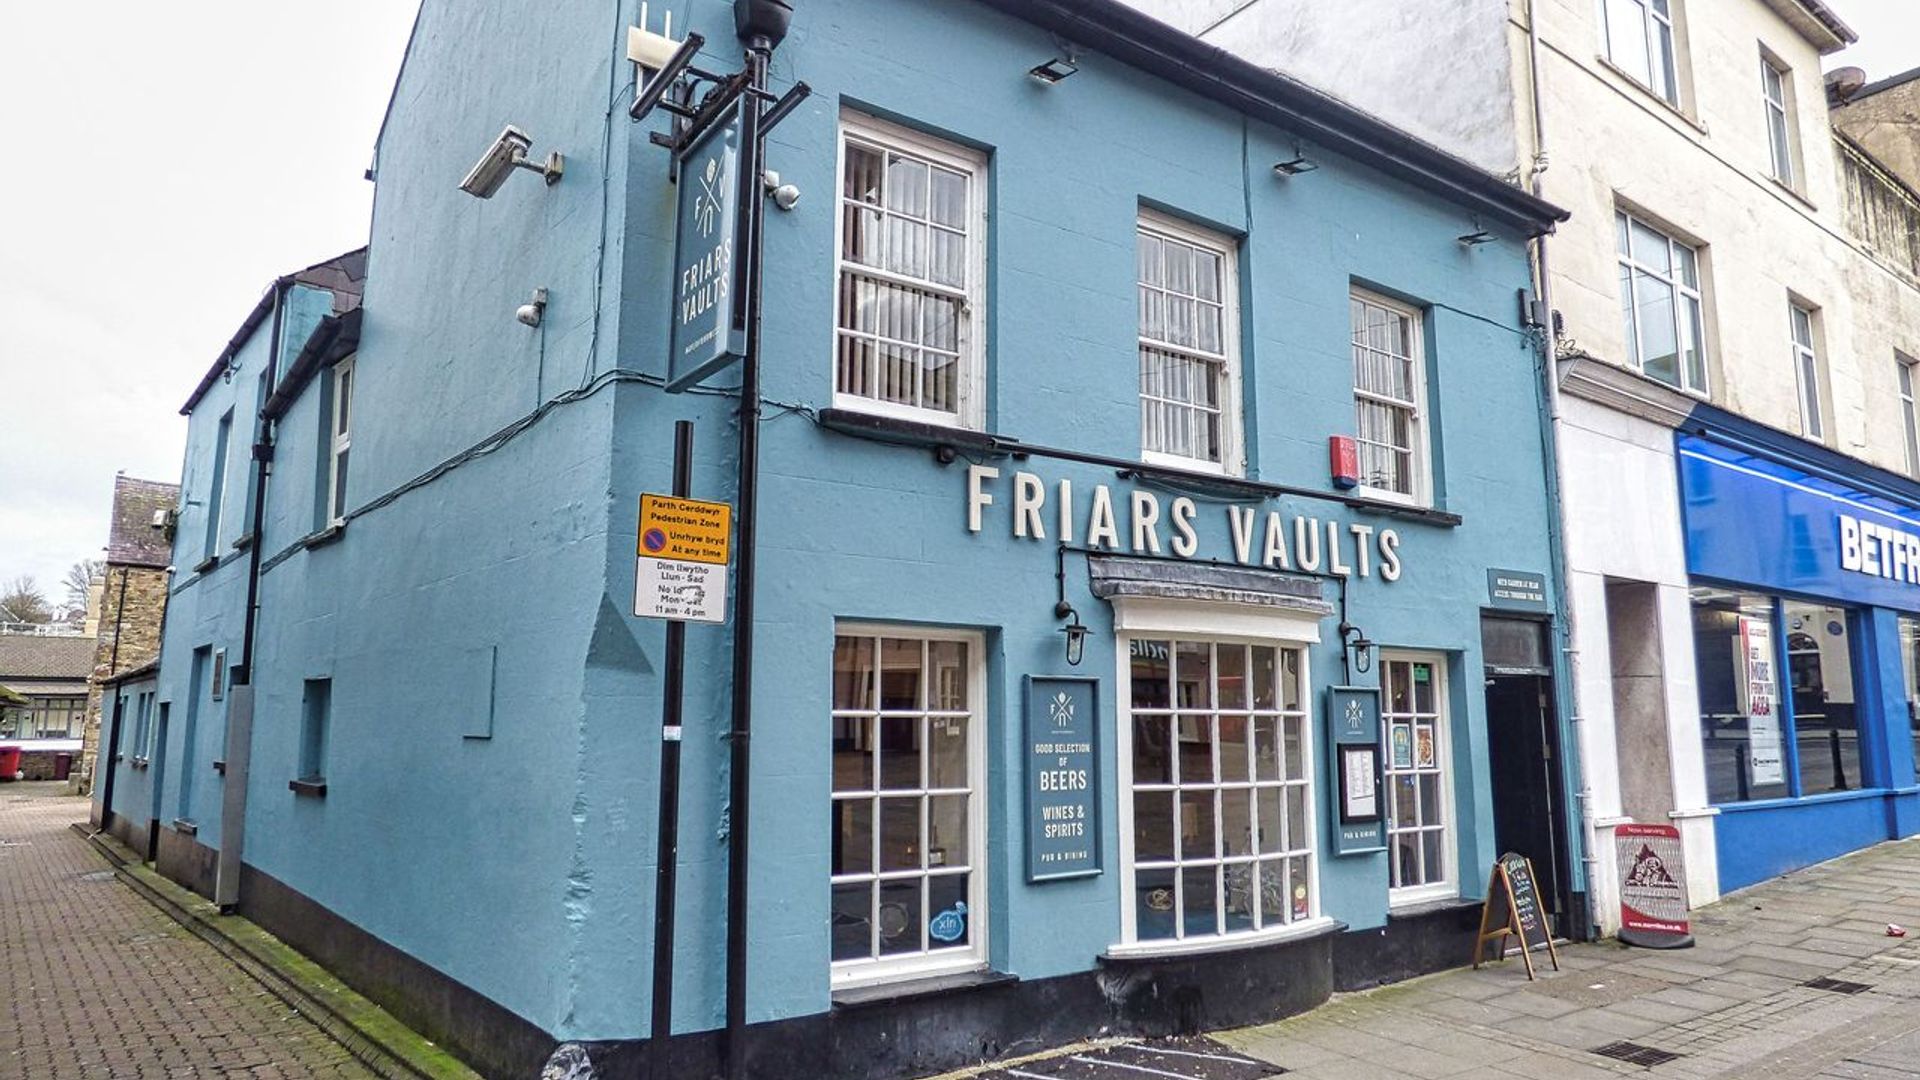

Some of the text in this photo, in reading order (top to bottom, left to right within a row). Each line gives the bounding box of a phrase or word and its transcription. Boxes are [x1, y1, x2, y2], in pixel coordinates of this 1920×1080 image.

[682, 237, 732, 296] FRIARS
[682, 272, 729, 325] VAULTS
[652, 500, 720, 516] Parth Cerddwyr
[651, 513, 720, 528] Pedestrian Zone
[968, 464, 1401, 582] FRIARS VAULTS
[670, 531, 725, 546] Unrhyw bryd
[672, 545, 721, 557] At any time
[1840, 514, 1920, 584] BETFR
[657, 562, 674, 571] Dim
[662, 572, 680, 581] Llun
[687, 575, 704, 583] Sad
[658, 585, 671, 593] No
[661, 595, 679, 604] Mon
[1035, 743, 1091, 753] GOOD SELECTION
[1059, 757, 1067, 767] OF
[1040, 770, 1087, 791] BEERS
[1042, 805, 1085, 821] WINES &
[1045, 822, 1084, 838] SPIRITS
[1041, 853, 1055, 863] PUB
